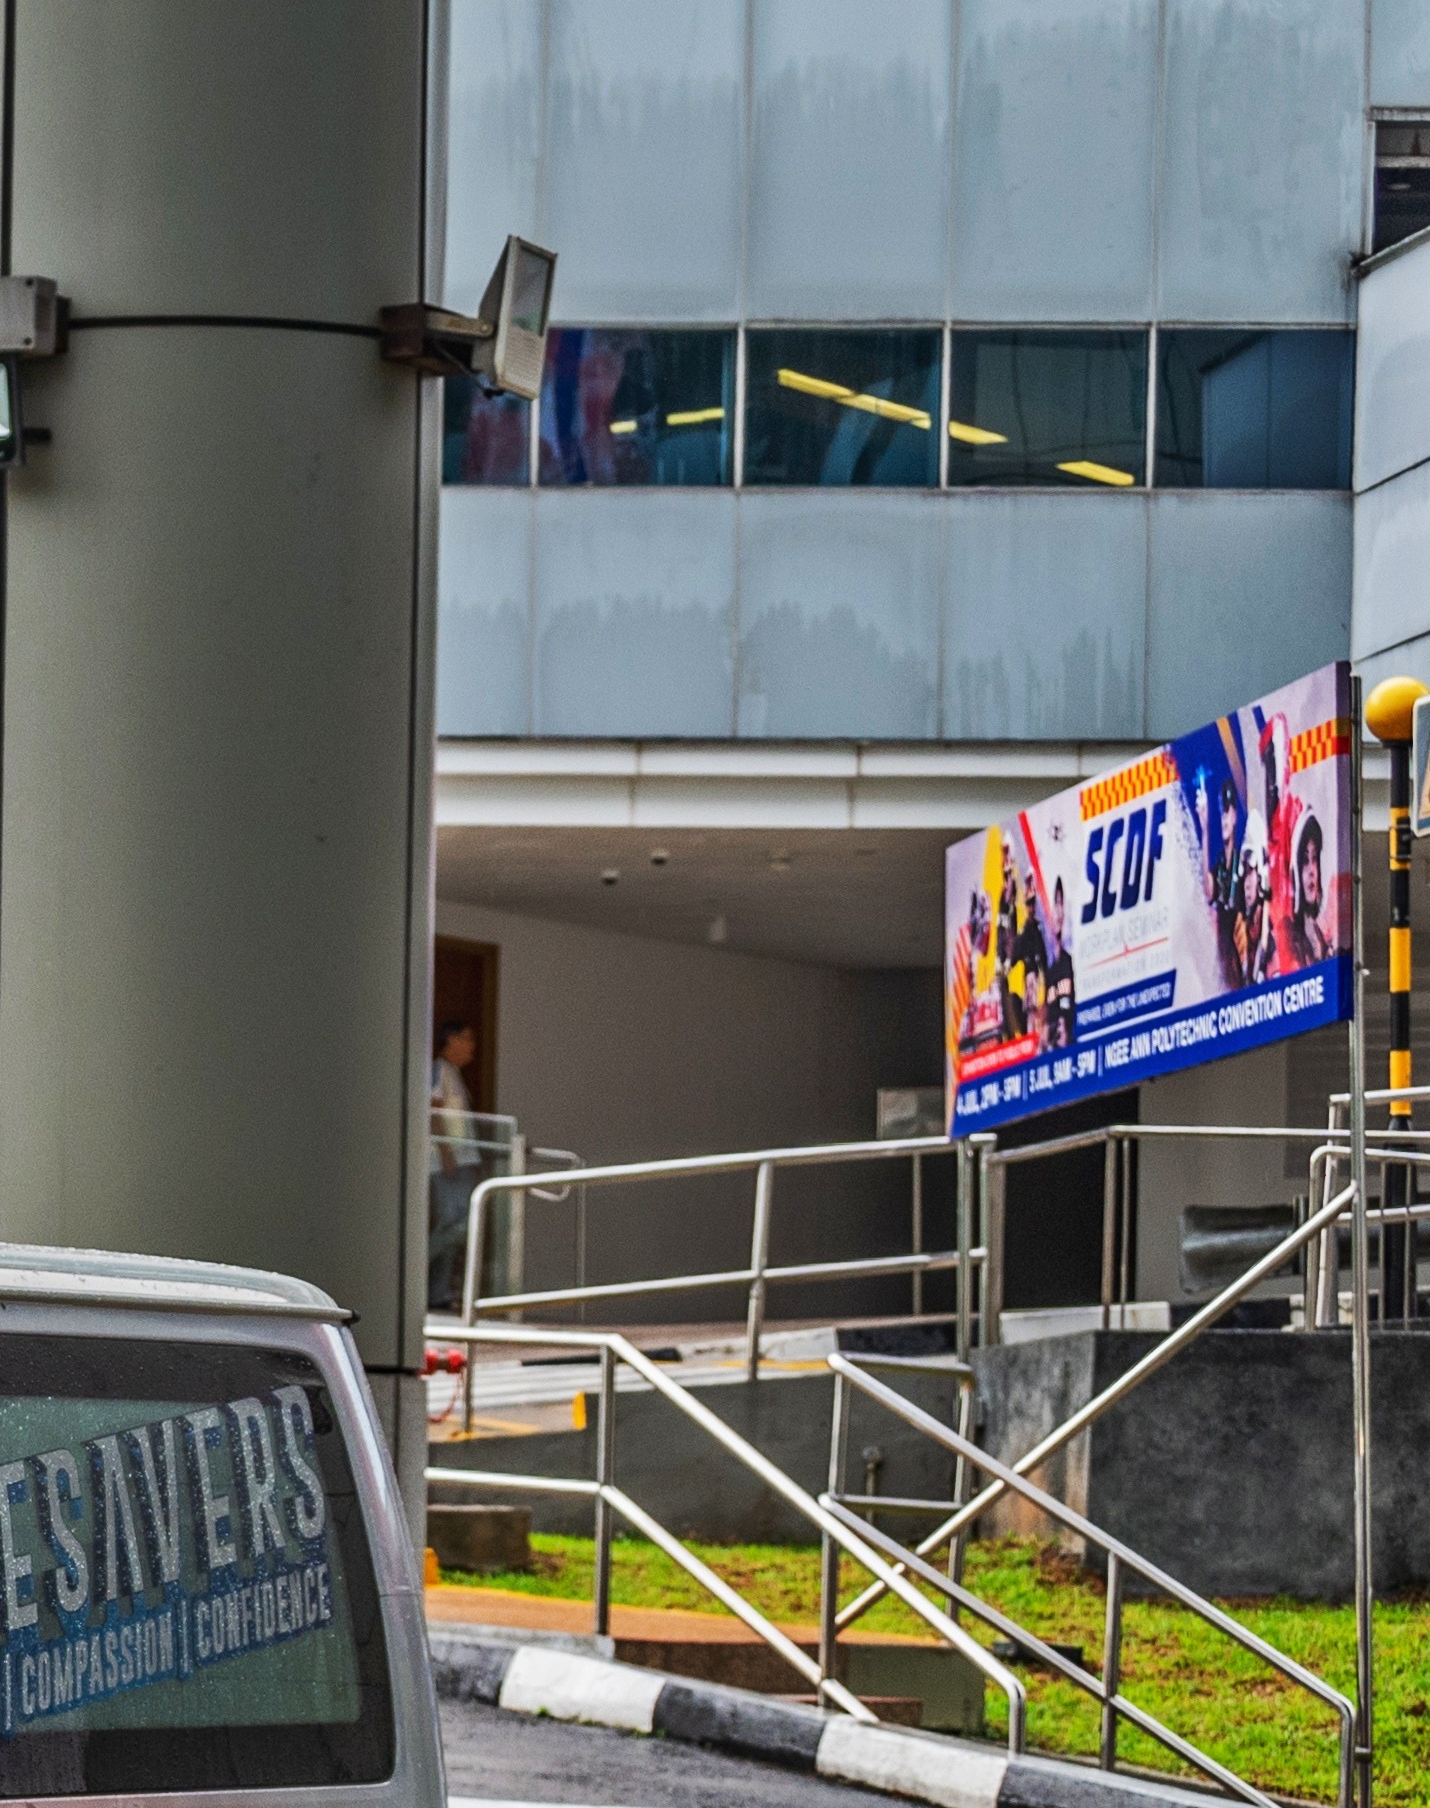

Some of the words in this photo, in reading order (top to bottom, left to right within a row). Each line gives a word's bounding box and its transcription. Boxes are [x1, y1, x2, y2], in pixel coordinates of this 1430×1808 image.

[1080, 798, 1168, 924] SCDF
[1104, 1037, 1129, 1069] NGEE
[1130, 1031, 1151, 1061] ANN
[1151, 1010, 1217, 1055] POLYTECHNIC
[1218, 990, 1283, 1036] CONVENTION
[1283, 975, 1324, 1014] CENTRE
[20, 1611, 176, 1717] COMPASSION
[195, 1562, 333, 1661] CONFIDENCE
